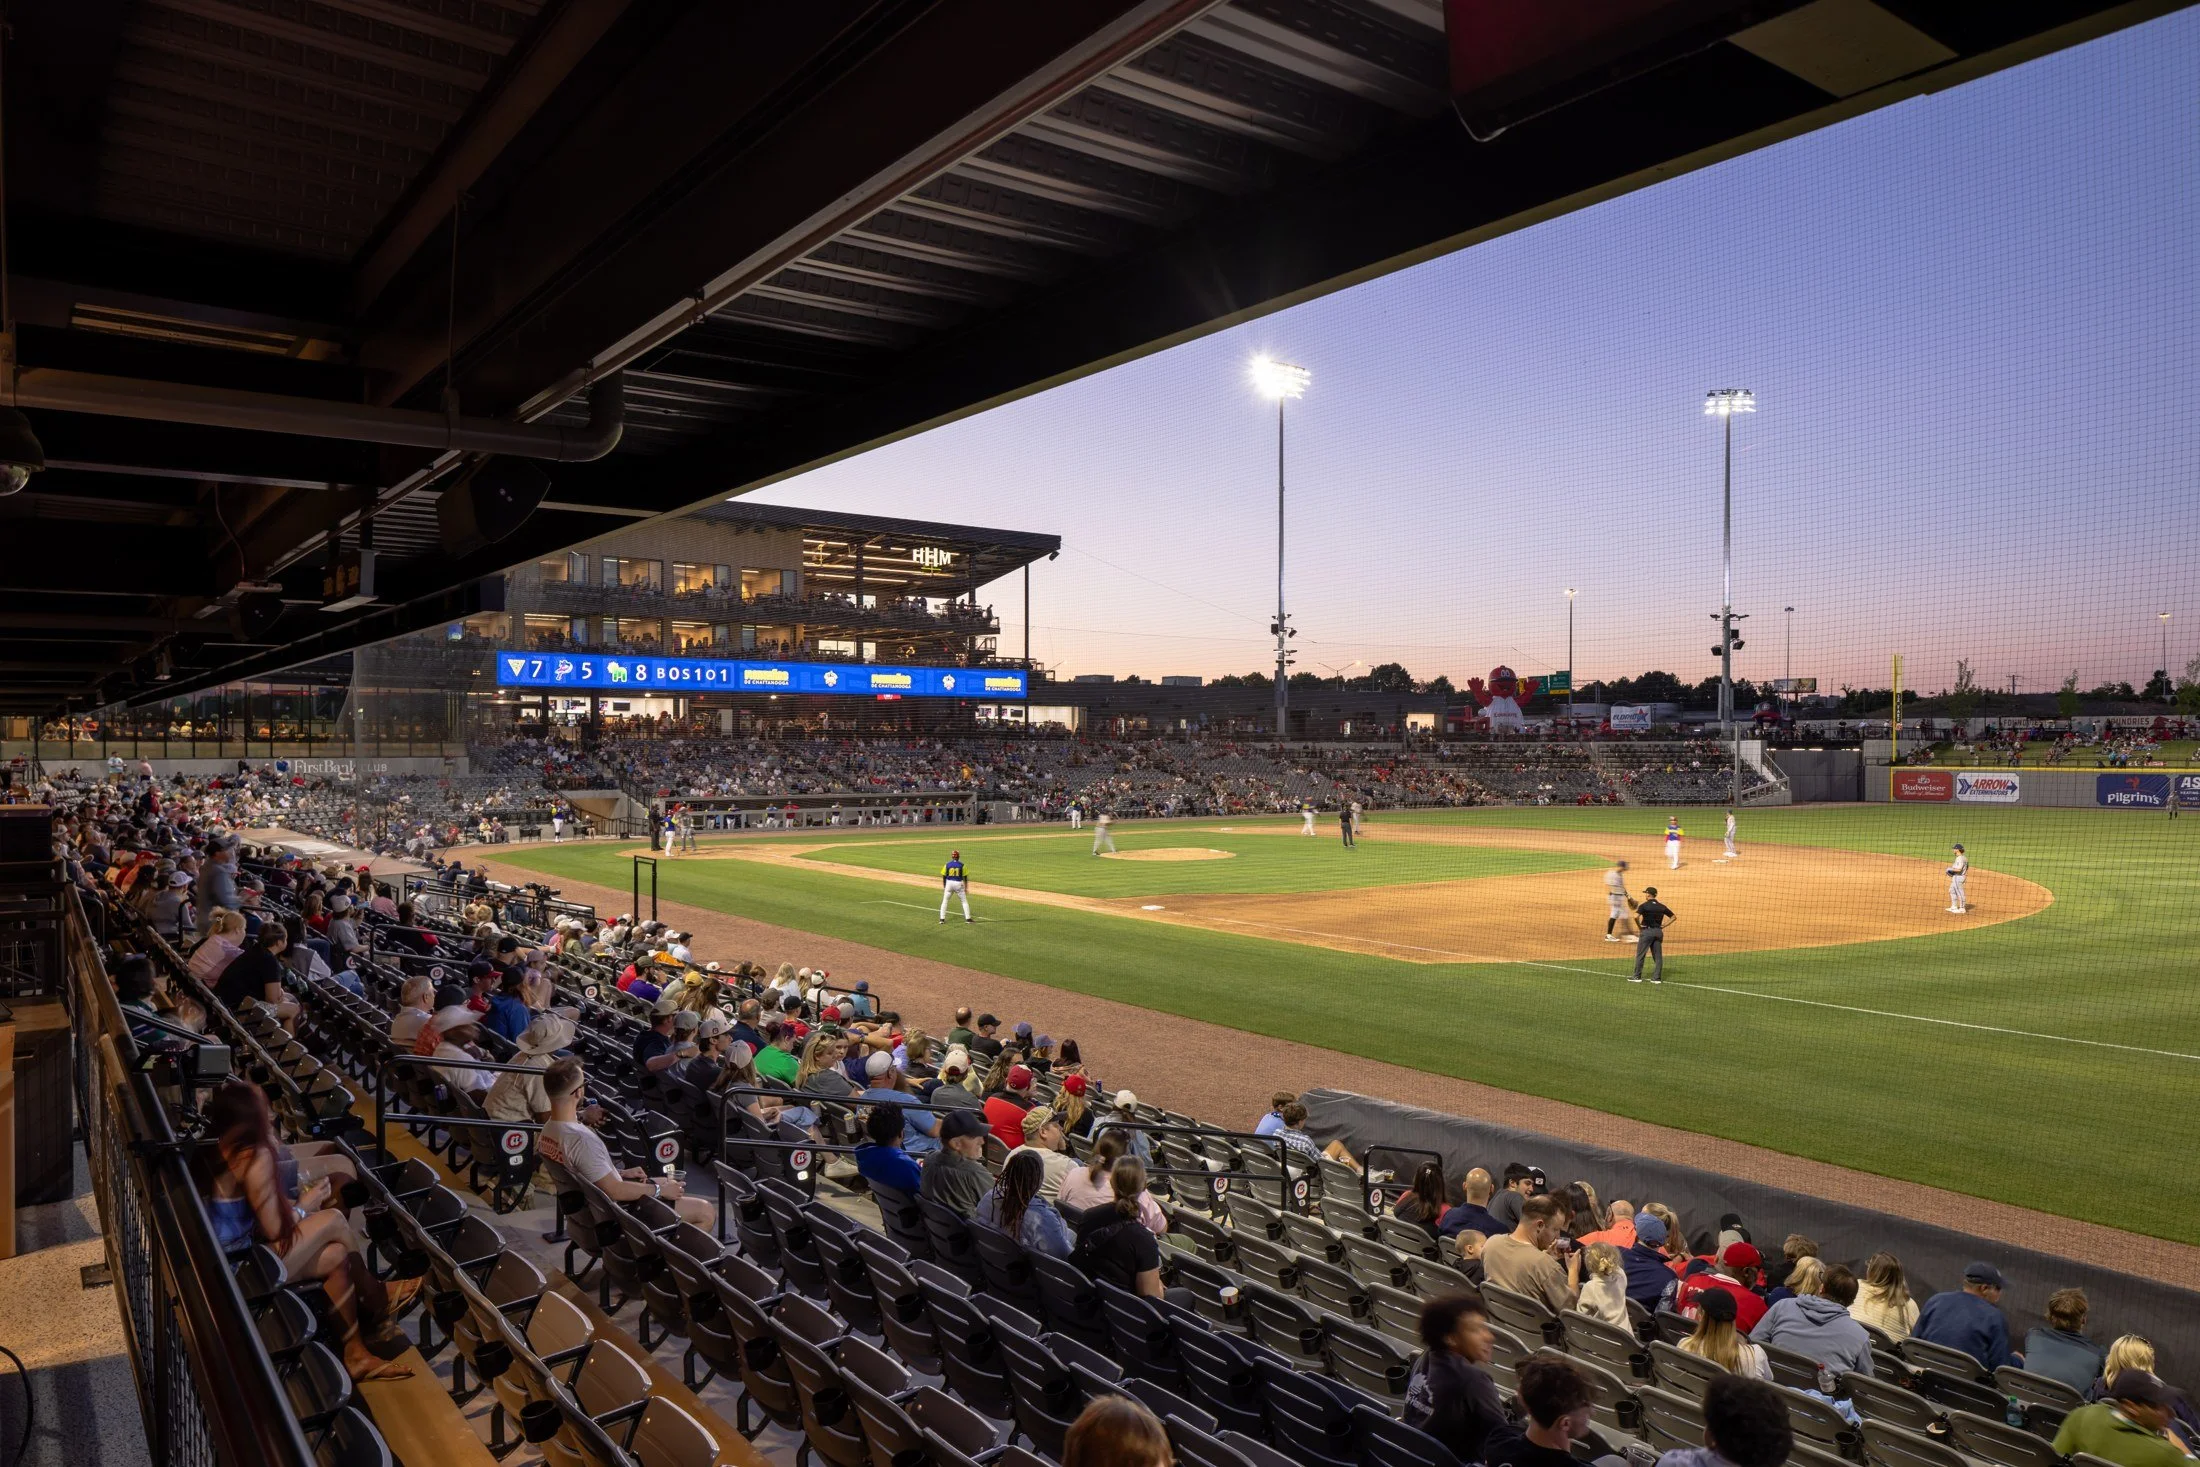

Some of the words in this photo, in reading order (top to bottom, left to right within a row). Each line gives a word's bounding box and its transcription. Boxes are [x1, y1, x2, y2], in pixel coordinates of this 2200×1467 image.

[912, 547, 951, 567] HHM
[530, 660, 543, 678] 7
[581, 661, 593, 679] 5
[635, 664, 648, 681] 8
[294, 759, 357, 773] FirstBank
[1901, 782, 1947, 792] Budweiser
[1971, 778, 2010, 790] ARROW
[1969, 788, 2009, 796] EXTERMINATORS
